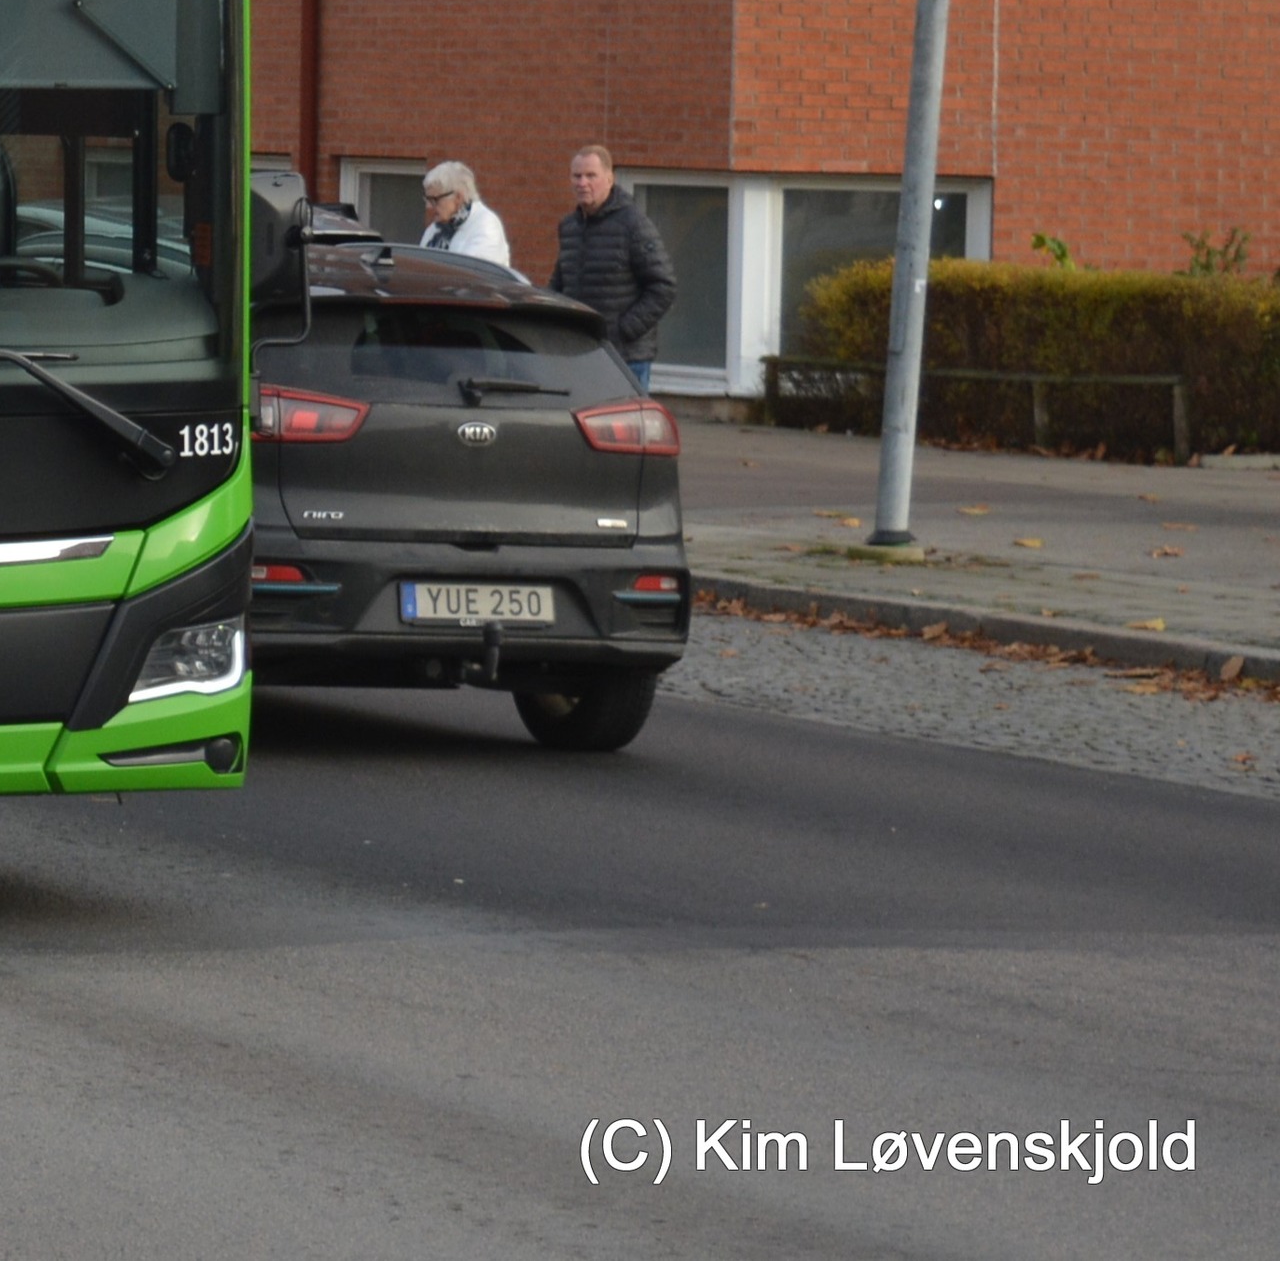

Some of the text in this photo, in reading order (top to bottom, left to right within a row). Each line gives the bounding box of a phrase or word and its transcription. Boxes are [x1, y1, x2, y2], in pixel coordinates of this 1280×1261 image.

[179, 422, 233, 457] 1813
[464, 426, 491, 440] KIA
[427, 587, 542, 616] YUE 250
